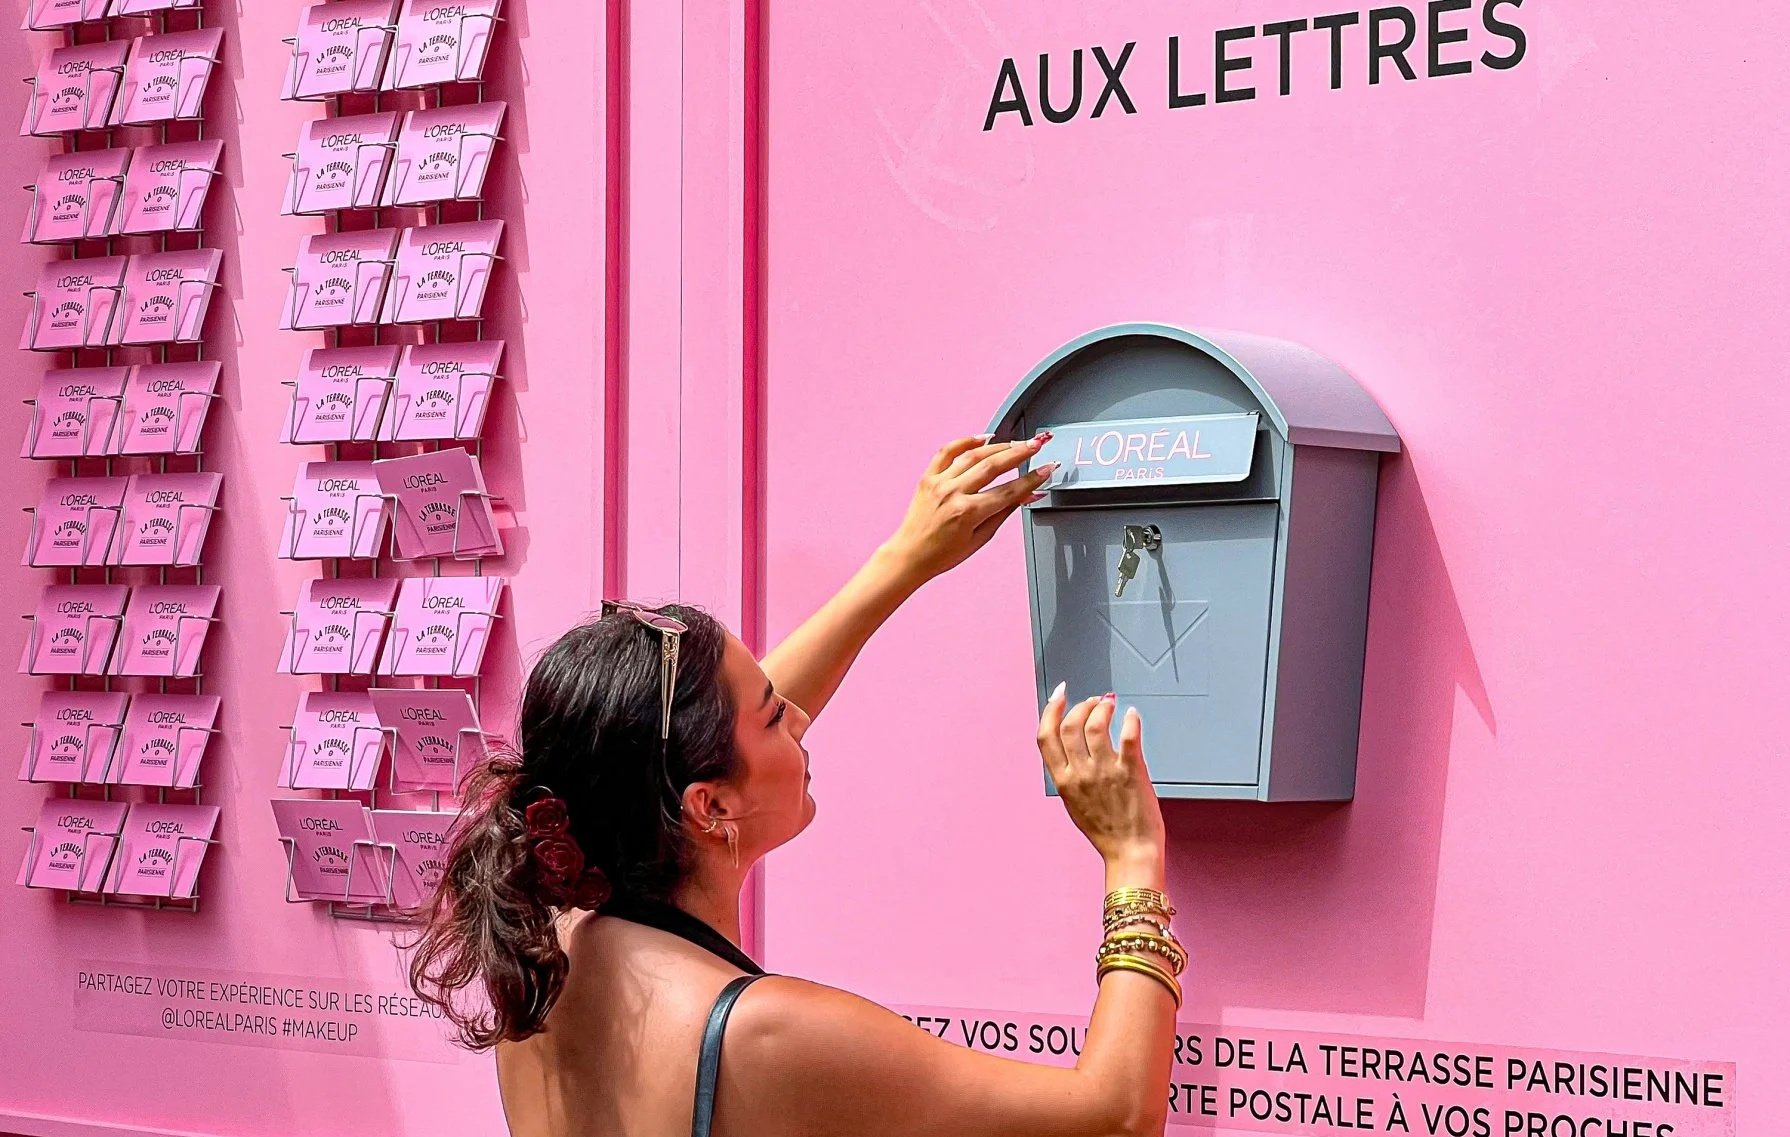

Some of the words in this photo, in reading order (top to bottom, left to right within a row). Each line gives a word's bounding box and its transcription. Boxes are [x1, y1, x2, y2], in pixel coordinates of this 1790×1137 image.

[423, 6, 467, 21] L'ORÉAL
[321, 17, 363, 32] L'ORÉAL
[419, 42, 428, 53] LA
[429, 35, 457, 48] TERRASSE
[317, 53, 325, 63] LA
[326, 46, 353, 59] TERRASSE
[418, 55, 449, 64] PARISIENNE
[58, 61, 95, 74] L'ORÉAL
[317, 65, 346, 74] PARISIENNE
[983, 41, 1138, 132] AUX
[1168, 0, 1527, 109] LETTRES
[143, 82, 152, 92] LA
[152, 76, 177, 89] TERRASSE
[52, 93, 61, 103] LA
[62, 87, 84, 100] TERRASSE
[424, 123, 468, 137] L'ORÉAL
[321, 134, 363, 147] L'ORÉAL
[150, 160, 187, 172] L'ORÉAL
[419, 159, 428, 170] LA
[429, 152, 456, 166] TERRASSE
[59, 168, 95, 180] L'ORÉAL
[317, 168, 325, 179] LA
[326, 161, 352, 176] TERRASSE
[418, 172, 449, 180] PARISIENNE
[316, 182, 345, 190] PARISIENNE
[144, 192, 152, 202] LA
[152, 186, 177, 198] TERRASSE
[54, 200, 62, 210] LA
[62, 194, 86, 208] TERRASSE
[422, 241, 465, 255] L'ORÉAL
[320, 250, 362, 263] L'ORÉAL
[57, 275, 94, 287] L'ORÉAL
[146, 269, 184, 281] L'ORÉAL
[417, 277, 426, 288] LA
[427, 270, 455, 285] TERRASSE
[315, 284, 324, 295] LA
[325, 278, 352, 293] TERRASSE
[52, 308, 59, 317] LA
[61, 302, 84, 314] TERRASSE
[140, 302, 149, 312] LA
[150, 296, 174, 308] TERRASSE
[322, 365, 363, 377] L'ORÉAL
[421, 362, 465, 374] L'ORÉAL
[59, 385, 96, 396] L'ORÉAL
[147, 380, 185, 392] L'ORÉAL
[316, 399, 325, 409] LA
[326, 393, 352, 408] TERRASSE
[416, 396, 425, 407] LA
[426, 390, 454, 405] TERRASSE
[53, 417, 61, 426] LA
[62, 411, 86, 423] TERRASSE
[141, 413, 149, 422] LA
[151, 407, 175, 420] TERRASSE
[1075, 428, 1211, 466] L'ORÉAL
[403, 473, 448, 489] L'ORÉAL
[1115, 467, 1164, 480] PARIS
[318, 479, 360, 491] L'ORÉAL
[60, 494, 97, 505] L'ORÉAL
[146, 491, 184, 502] L'ORÉAL
[313, 513, 322, 524] LA
[323, 508, 350, 523] TERRASSE
[419, 510, 428, 521] LA
[425, 503, 456, 517] TERRASSE
[55, 526, 62, 535] LA
[64, 520, 86, 533] TERRASSE
[140, 524, 149, 534] LA
[149, 518, 174, 532] TERRASSE
[57, 602, 94, 612] L'ORÉAL
[149, 602, 188, 613] L'ORÉAL
[320, 597, 361, 608] L'ORÉAL
[422, 597, 466, 608] L'ORÉAL
[52, 633, 59, 643] LA
[60, 628, 83, 641] TERRASSE
[143, 635, 151, 644] LA
[152, 630, 176, 643] TERRASSE
[314, 630, 323, 640] LA
[324, 625, 351, 640] TERRASSE
[416, 631, 425, 641] LA
[427, 624, 454, 641] TERRASSE
[57, 709, 94, 720] L'ORÉAL
[148, 712, 186, 723] L'ORÉAL
[319, 710, 360, 722] L'ORÉAL
[400, 708, 447, 721] L'ORÉAL
[51, 741, 59, 751] LA
[60, 736, 83, 749] TERRASSE
[142, 744, 149, 754] LA
[151, 739, 175, 752] TERRASSE
[314, 745, 322, 755] LA
[323, 739, 350, 755] TERRASSE
[416, 740, 424, 751] LA
[422, 736, 453, 753] TERRASSE
[58, 816, 94, 828] L'ORÉAL
[146, 821, 184, 833] L'ORÉAL
[300, 818, 343, 830] L'ORÉAL
[51, 848, 59, 857] LA
[60, 843, 83, 857] TERRASSE
[139, 854, 147, 863] LA
[148, 849, 172, 862] TERRASSE
[313, 851, 321, 862] LA
[318, 847, 349, 863] TERRASSE
[416, 865, 424, 875] LA
[78, 972, 152, 995] PARTAGEZ
[157, 979, 205, 1000] VOTRE
[210, 982, 303, 1008] EXPÉRIENCE
[308, 991, 340, 1011] SUR
[344, 994, 372, 1013] LES
[378, 993, 446, 1019] RÉSEAU
[161, 1007, 277, 1035] @LOREALPARIS
[282, 1021, 358, 1042] #MAKEUP
[960, 1020, 1018, 1052] VOS
[1215, 1039, 1255, 1070] DE
[1267, 1040, 1308, 1073] LA
[1319, 1044, 1494, 1089] TERRASSE
[1507, 1058, 1723, 1107] PARISIENNE
[1170, 1083, 1217, 1115] RTE
[1230, 1088, 1374, 1130] POSTALE
[1386, 1093, 1409, 1132] À
[1421, 1103, 1491, 1137] VOS
